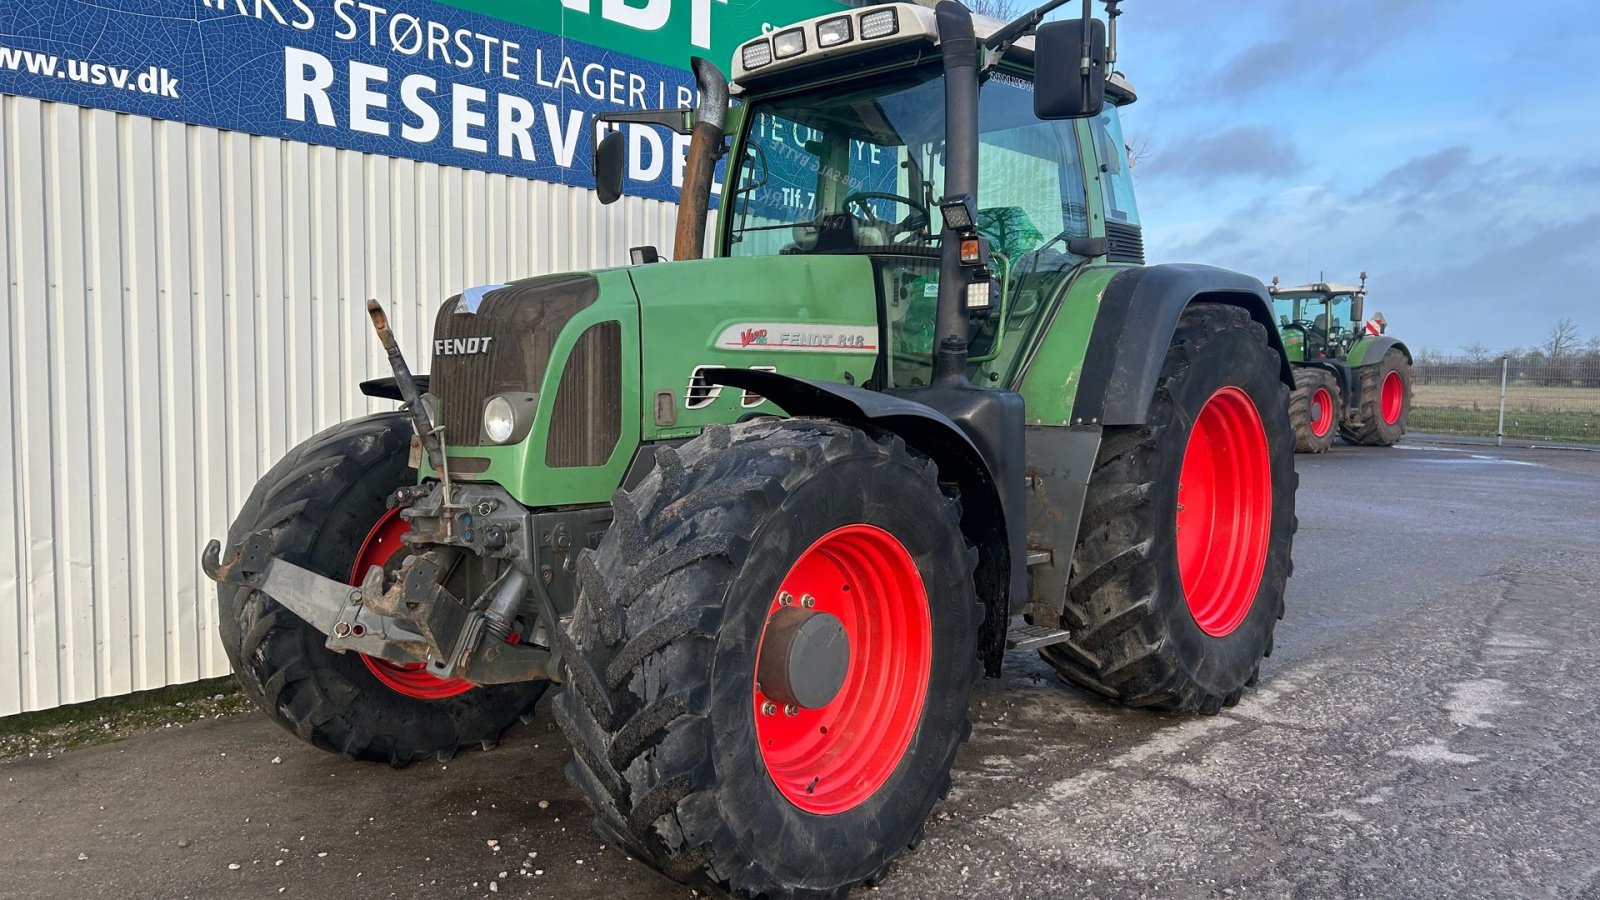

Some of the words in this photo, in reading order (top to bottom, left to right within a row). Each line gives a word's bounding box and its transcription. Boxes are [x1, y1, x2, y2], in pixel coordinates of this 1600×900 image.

[334, 0, 520, 80] STØRSTE
[536, 48, 647, 110] LAGER
[659, 80, 665, 110] I
[848, 138, 881, 165] YE
[435, 336, 493, 356] FENDT
[780, 332, 833, 347] FENDT
[837, 334, 865, 348] 818
